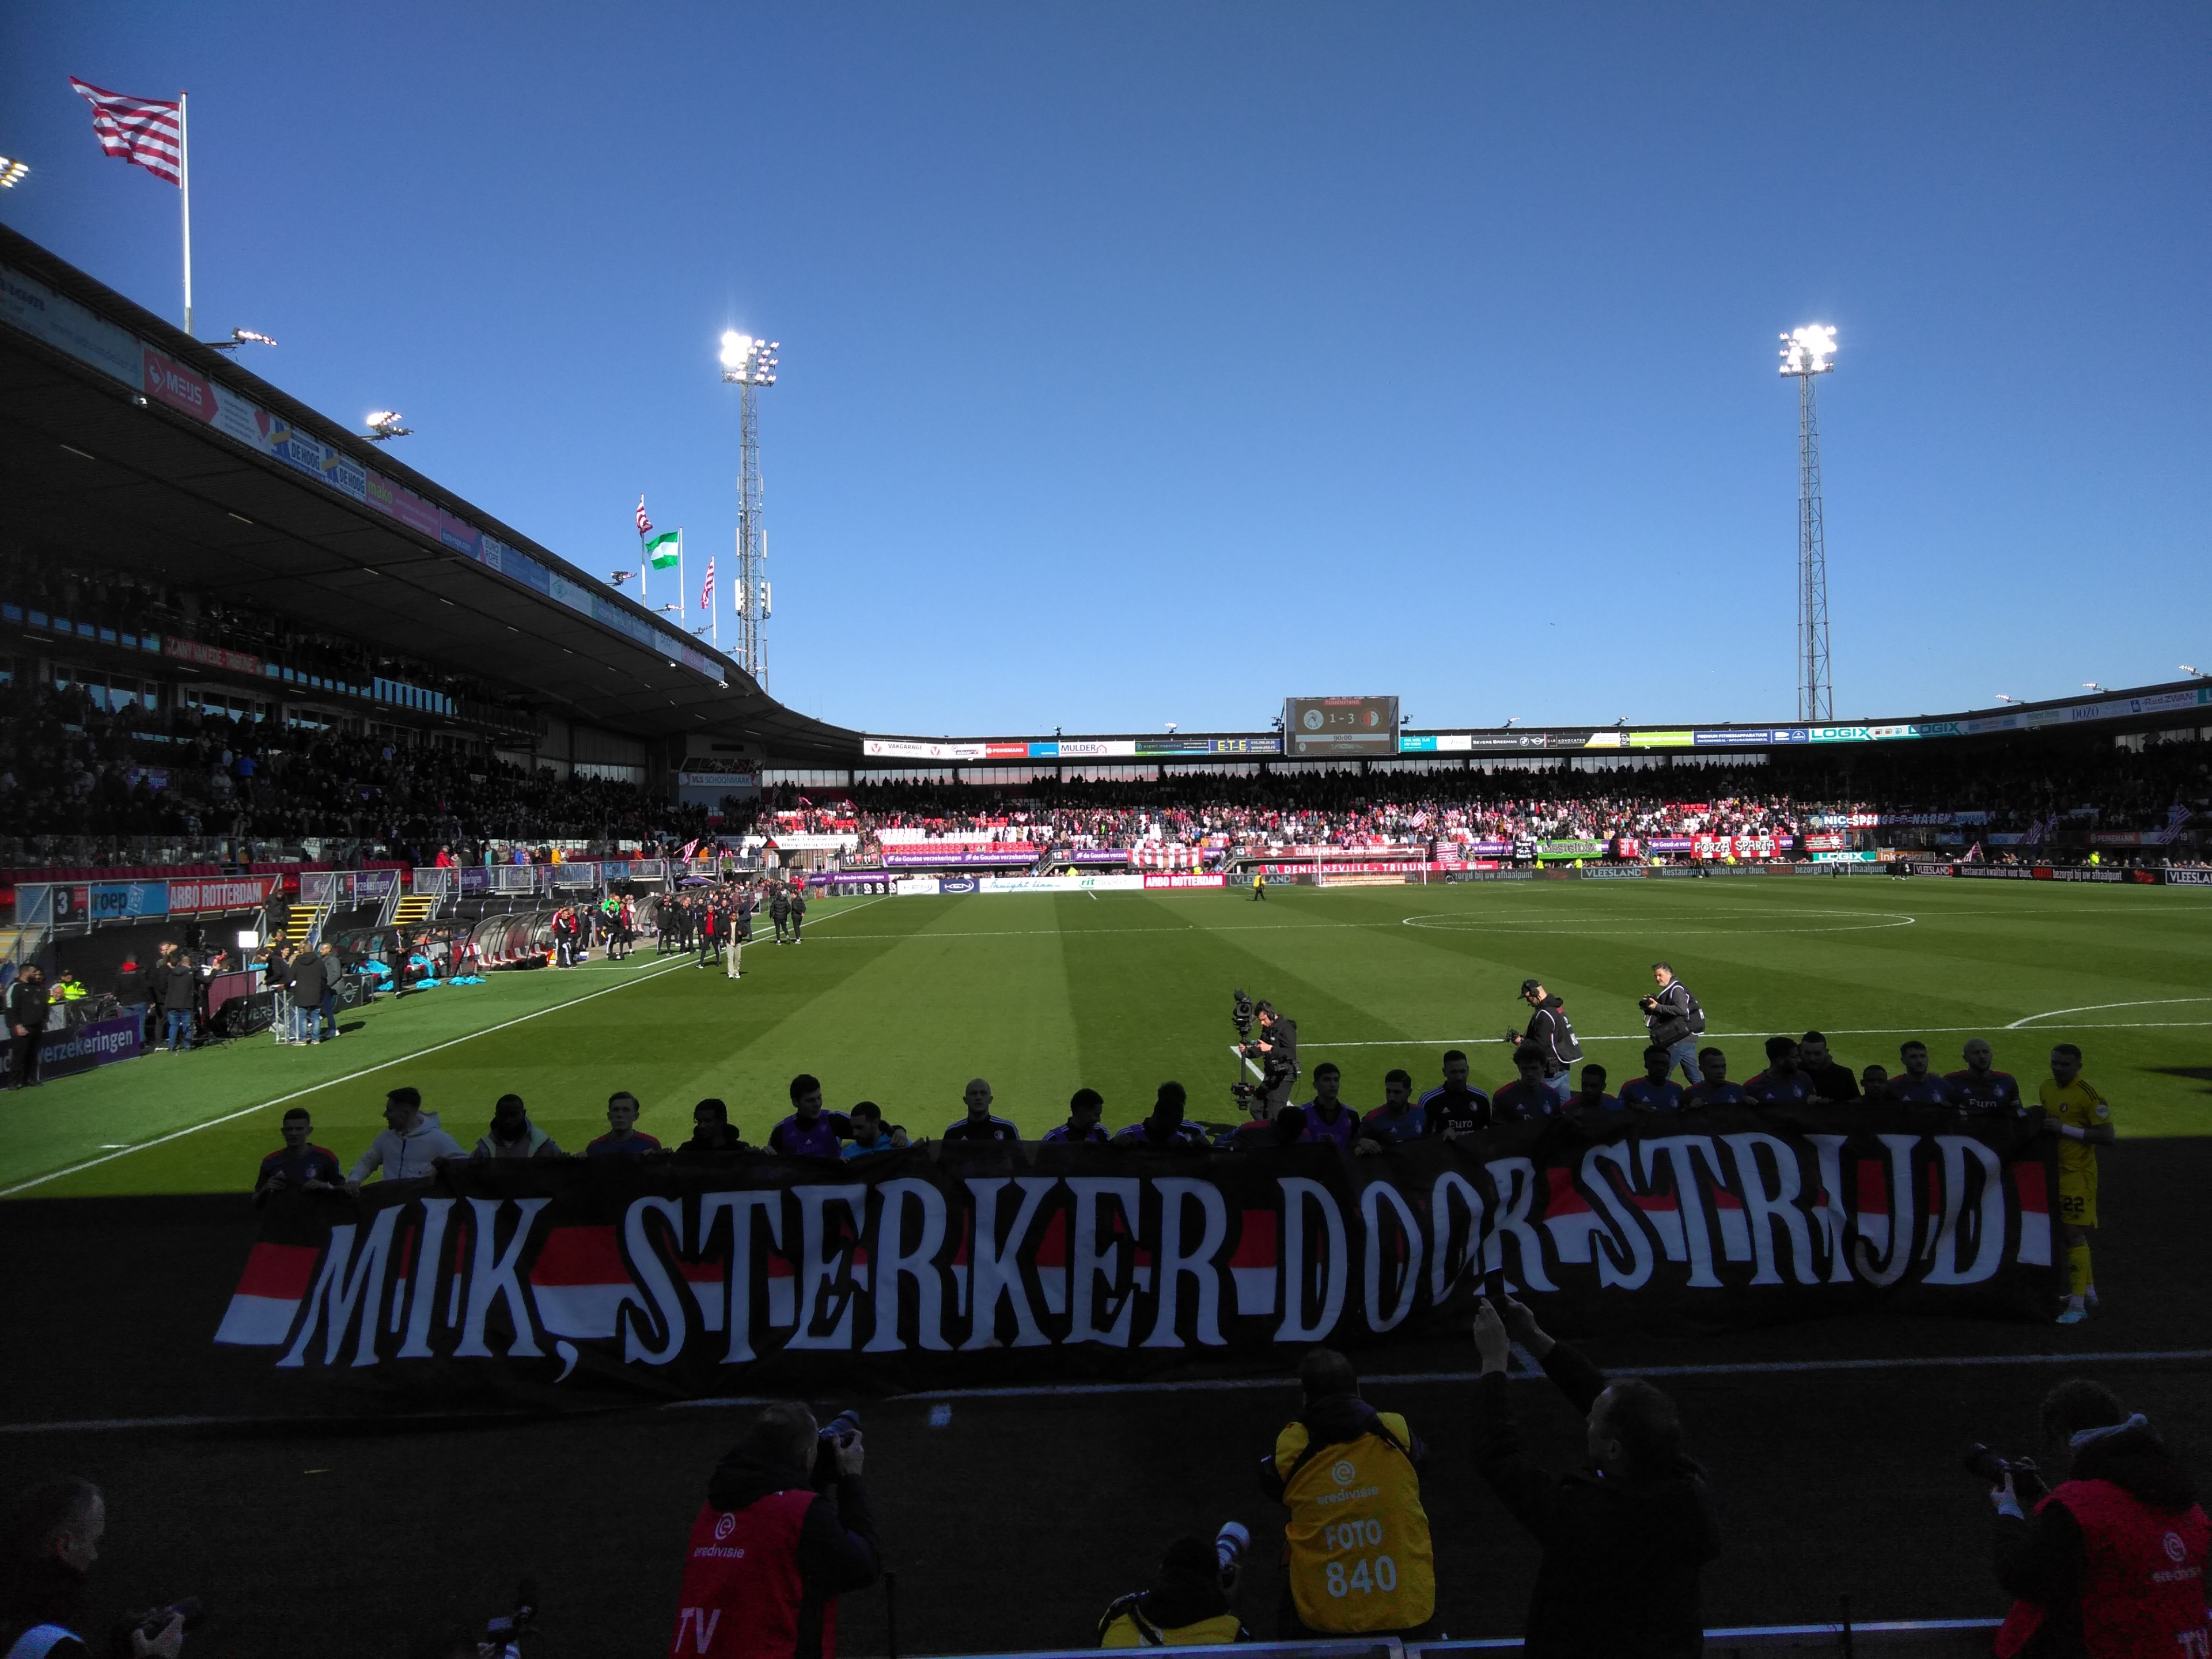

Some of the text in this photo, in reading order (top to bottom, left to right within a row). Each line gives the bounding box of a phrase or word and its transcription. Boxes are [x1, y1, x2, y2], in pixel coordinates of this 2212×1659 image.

[291, 441, 320, 471] DE HOOG
[339, 467, 365, 495] DE HOOG
[368, 480, 393, 505] mako
[192, 644, 208, 661] VAN
[208, 647, 222, 665] EDE
[226, 652, 254, 673] TRIBUNE
[1329, 714, 1336, 723] 1
[1347, 713, 1355, 724] 3
[2071, 706, 2099, 721] DOZO
[1811, 728, 1874, 740] LOGIX
[1908, 722, 1963, 735] LOGIX
[1694, 839, 1777, 853] FORZA SPARTA
[923, 854, 962, 862] verzekeringen
[1818, 852, 1866, 862] LOGIX
[1284, 865, 1318, 873] DENIS
[1382, 862, 1432, 872] TRIBUNE
[1453, 872, 1473, 881] zorgd
[1475, 871, 1484, 881] bij
[1497, 870, 1533, 880] afhaalpunt
[1585, 868, 1641, 877] VLEESLAND
[1749, 866, 1767, 875] thuis,
[1769, 866, 1793, 874] GRATIS
[1795, 865, 1822, 875] bezorgd
[1824, 865, 1832, 874] bij
[1916, 865, 1949, 875] VLEESLAND
[1961, 866, 1986, 876] Restaurant
[1986, 866, 2007, 876] kwaliteit
[2008, 869, 2018, 877] voor
[2018, 868, 2033, 879] thuis,
[2052, 869, 2074, 881] bezorgd
[2074, 869, 2082, 881] bij
[2092, 870, 2123, 882] afhaalpunt
[337, 878, 344, 895] 4
[446, 873, 452, 887] 5
[1146, 875, 1223, 888] ARBO ROTTERDAM
[169, 882, 262, 910] ARBO ROTTERDAM
[356, 880, 389, 897] erzekeringen
[57, 891, 69, 915] 3
[37, 1029, 134, 1065] verzekeringen
[1969, 1098, 1998, 1108] Euro
[1448, 1119, 1473, 1129] Euro
[2063, 1196, 2084, 1213] 22
[275, 1131, 2006, 1383] MIK, STERKER DOOR STRIJD
[1316, 1484, 1380, 1506] eredivisie
[1325, 1518, 1384, 1551] FOTO
[693, 1543, 745, 1559] eredivisie
[1325, 1555, 1398, 1599] 840
[674, 1607, 723, 1655] TV
